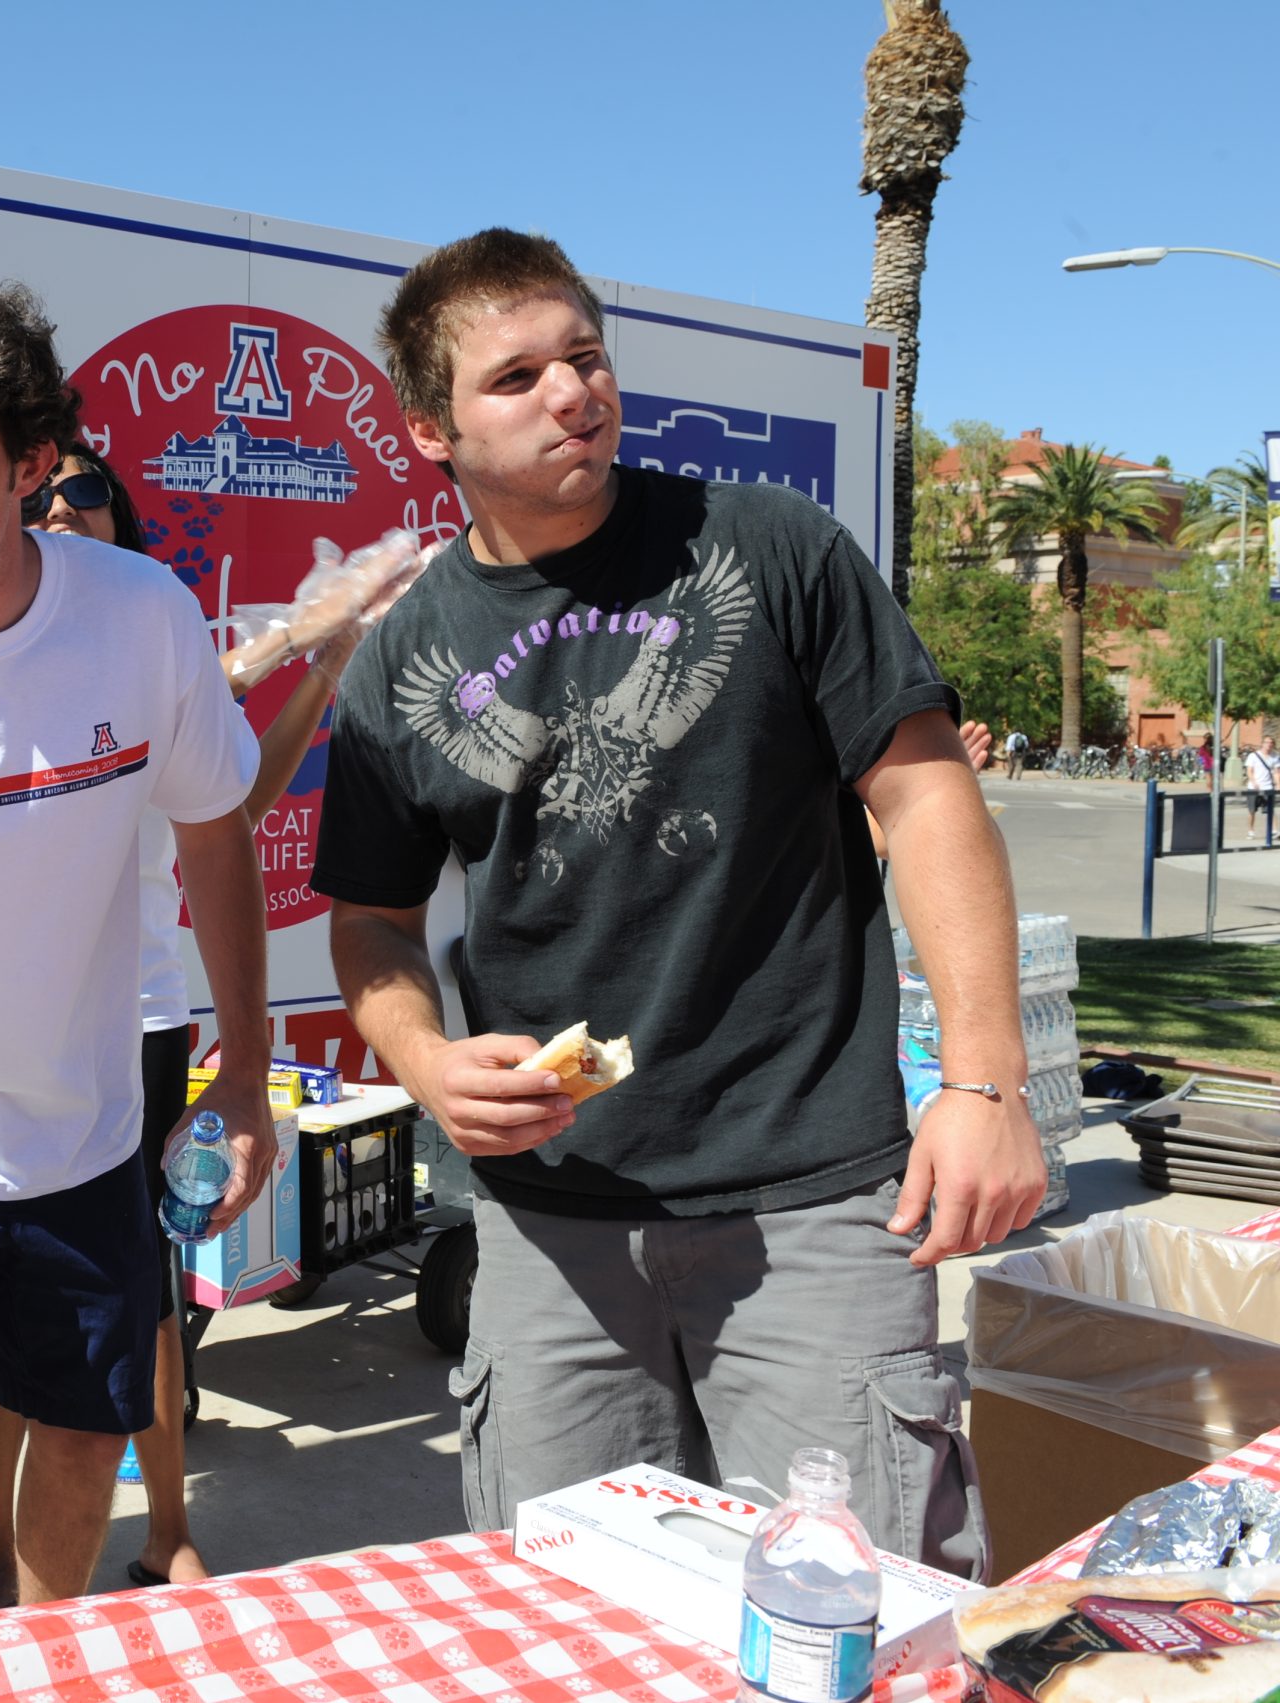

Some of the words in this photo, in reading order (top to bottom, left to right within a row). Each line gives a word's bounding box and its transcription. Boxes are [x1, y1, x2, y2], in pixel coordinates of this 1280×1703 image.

[101, 352, 205, 416] No
[302, 347, 411, 483] Place
[457, 600, 681, 719] Salvation
[42, 763, 99, 782] Homecoming
[1, 792, 33, 804] UNIVERSITY
[34, 790, 42, 798] OF
[44, 786, 68, 796] ARIZONA
[252, 808, 313, 837] CAT
[261, 842, 309, 872] LIFE
[598, 1480, 758, 1515] SYSCO
[645, 1474, 720, 1502] Classic
[524, 1529, 575, 1554] SYSCO
[917, 1568, 970, 1590] Gloves
[1116, 1622, 1140, 1639] DOG
[1137, 1638, 1159, 1655] BUN
